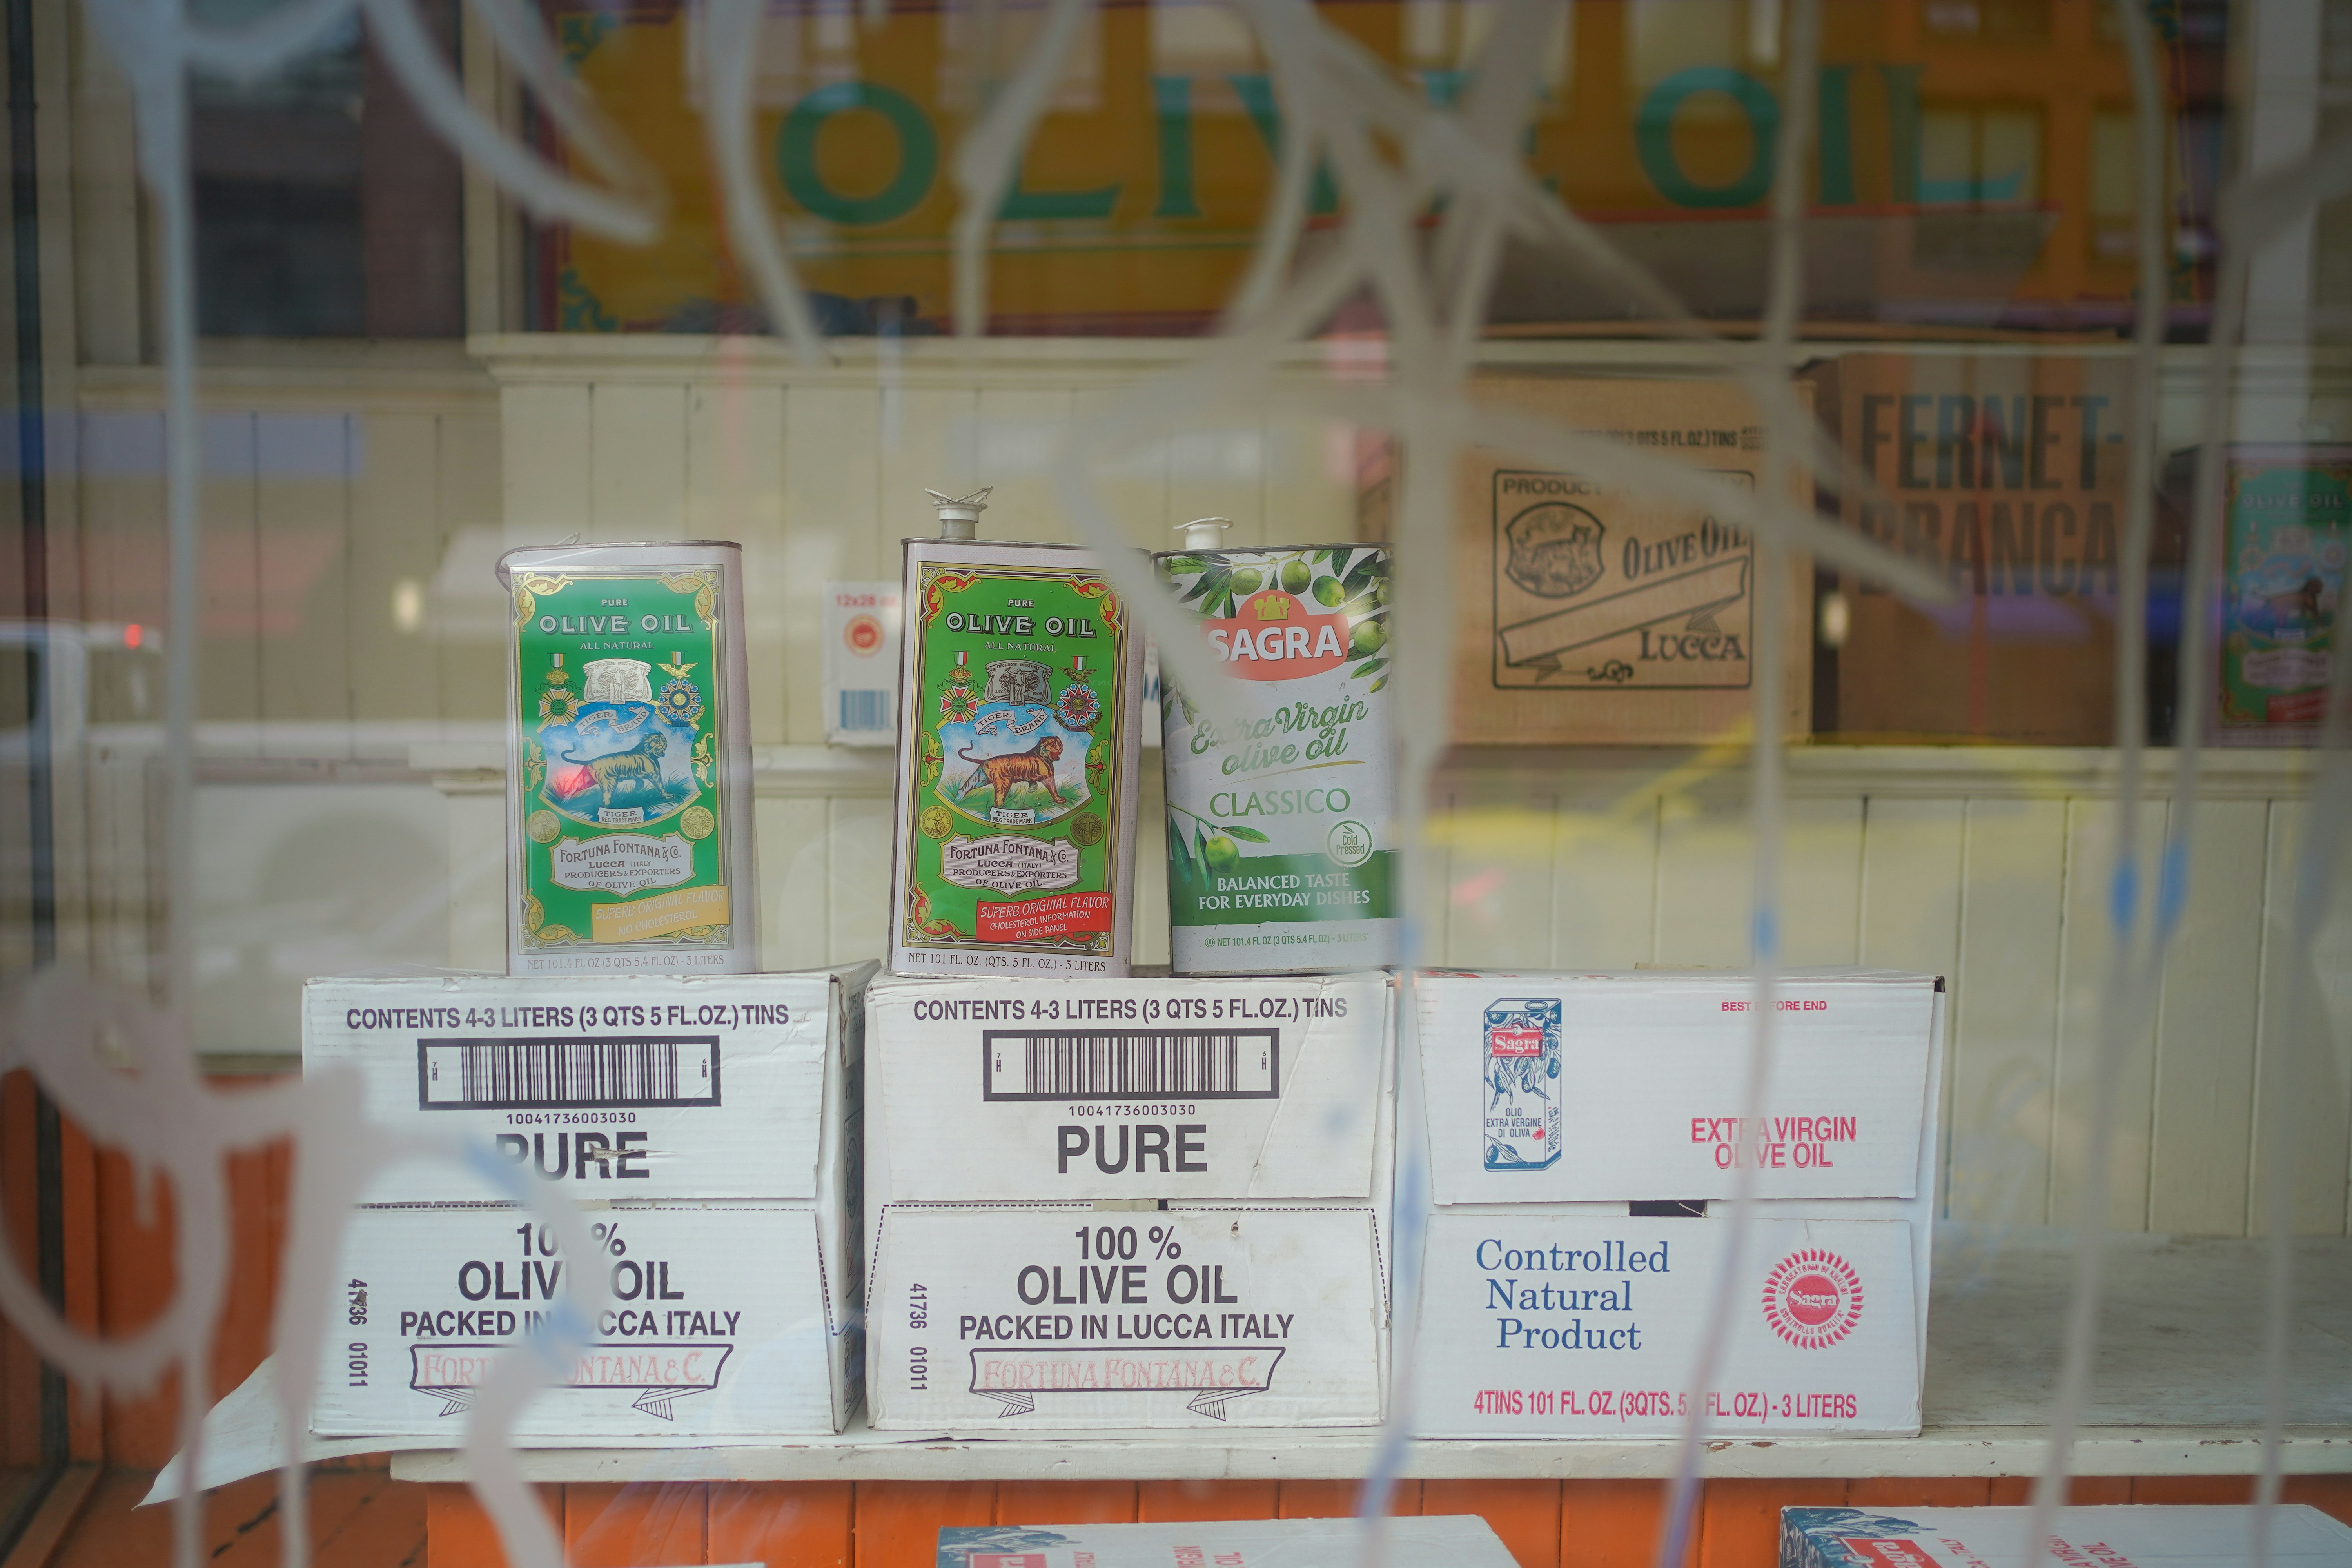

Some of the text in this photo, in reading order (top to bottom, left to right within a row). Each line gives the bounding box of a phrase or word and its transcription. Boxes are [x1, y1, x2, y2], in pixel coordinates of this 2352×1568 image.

[1634, 64, 2027, 208] OIL
[1712, 430, 1737, 446] TINS
[1622, 532, 1697, 581] OLIVE
[1700, 515, 1748, 558] OIL
[1007, 599, 1034, 608] PURE
[539, 614, 695, 635] OLIVE OIL
[946, 612, 1097, 638] OLIVE OIL
[984, 642, 1057, 652] ALL NATURAL
[1208, 625, 1343, 662] SAGRA
[1639, 629, 1746, 661] LUCCA
[579, 711, 613, 727] TIGER
[617, 711, 647, 732] BRAND
[978, 712, 1012, 727] TIGER
[1014, 714, 1045, 734] BRAND
[1275, 695, 1369, 739] Virgin
[1222, 728, 1348, 775] olive oil
[1210, 788, 1350, 817] CLASSICO
[560, 839, 660, 862] FORTUNA FONTANA
[951, 840, 1050, 862] FORTUNA FONTANA
[1336, 844, 1365, 855] Pressed
[1343, 835, 1357, 845] Cold
[589, 860, 625, 869] LUCCA
[639, 877, 656, 886] OIL
[1025, 880, 1043, 888] OIL
[1217, 873, 1350, 892] BALANCED TASTE
[638, 893, 682, 914] ORIGINAL
[686, 889, 725, 903] FLAVOR
[1022, 897, 1067, 915] ORIGINAL
[1071, 896, 1109, 909] FLAVOR
[1199, 890, 1370, 910] FOR EVERYDAY DISHES
[619, 909, 697, 936] NO CHOLESTEROL
[990, 910, 1091, 931] CHOLESTEROL INFORMATION
[1016, 924, 1067, 939] ON SIDE PANEL
[1218, 933, 1367, 947] NET 101.4 OZ QTS 5.4 OZ) LITERS
[527, 955, 724, 969] NET 101.4 FL OZ QTS 5.4 OZ) LITERS
[909, 953, 1106, 972] NET 101 FL. OZ. (QTS. FL. OZ.) LITERS
[913, 1000, 1025, 1021] CONTENTS
[1030, 1000, 1060, 1020] 4-3
[1066, 999, 1136, 1020] LITERS
[1143, 999, 1160, 1024] (3
[1166, 998, 1207, 1020] QTS
[1212, 998, 1223, 1019] 5
[1302, 997, 1347, 1018] TINS
[1721, 1001, 1752, 1011] BEST
[1803, 1001, 1828, 1011] END
[347, 1007, 461, 1031] CONTENTS
[466, 1007, 495, 1028] 4-3
[501, 1005, 574, 1028] LITERS
[579, 1005, 597, 1032] (3
[603, 1005, 645, 1028] QTS
[650, 1005, 662, 1027] 5
[741, 1004, 789, 1025] TINS
[1494, 1035, 1540, 1054] Sagra
[506, 1113, 636, 1126] 10041736003030
[1068, 1105, 1196, 1116] 10041736003030
[1506, 1108, 1522, 1117] OLIO
[1486, 1118, 1542, 1127] EXTRA VERGINE
[1498, 1128, 1530, 1137] DI OLIVA
[1774, 1116, 1856, 1142] VIRGIN
[496, 1132, 650, 1181] PURE
[1058, 1124, 1208, 1175] PURE
[1715, 1142, 1833, 1169] OLVE OIL
[1075, 1226, 1182, 1261] 100 %
[1476, 1239, 1670, 1273] Controlled
[458, 1260, 684, 1301] OLIV OIL
[1017, 1264, 1238, 1305] OLIVE OIL
[909, 1282, 927, 1330] 41736
[1485, 1279, 1633, 1311] Natural
[1789, 1290, 1837, 1309] Sagra
[401, 1311, 515, 1336] PACKED
[667, 1310, 741, 1336] ITALY
[960, 1313, 1294, 1340] PACKED IN LUCCA ITALY
[1495, 1317, 1642, 1350] Product
[348, 1342, 368, 1387] 01011
[910, 1347, 927, 1391] 01011
[983, 1358, 1097, 1390] FORTUNA
[1528, 1390, 1555, 1415] 101
[1561, 1390, 1586, 1416] FL.
[1588, 1391, 1616, 1416] OZ.
[1706, 1391, 1730, 1417] FL.
[1734, 1392, 1768, 1423] OZ.)
[1796, 1393, 1857, 1419] LITERS
